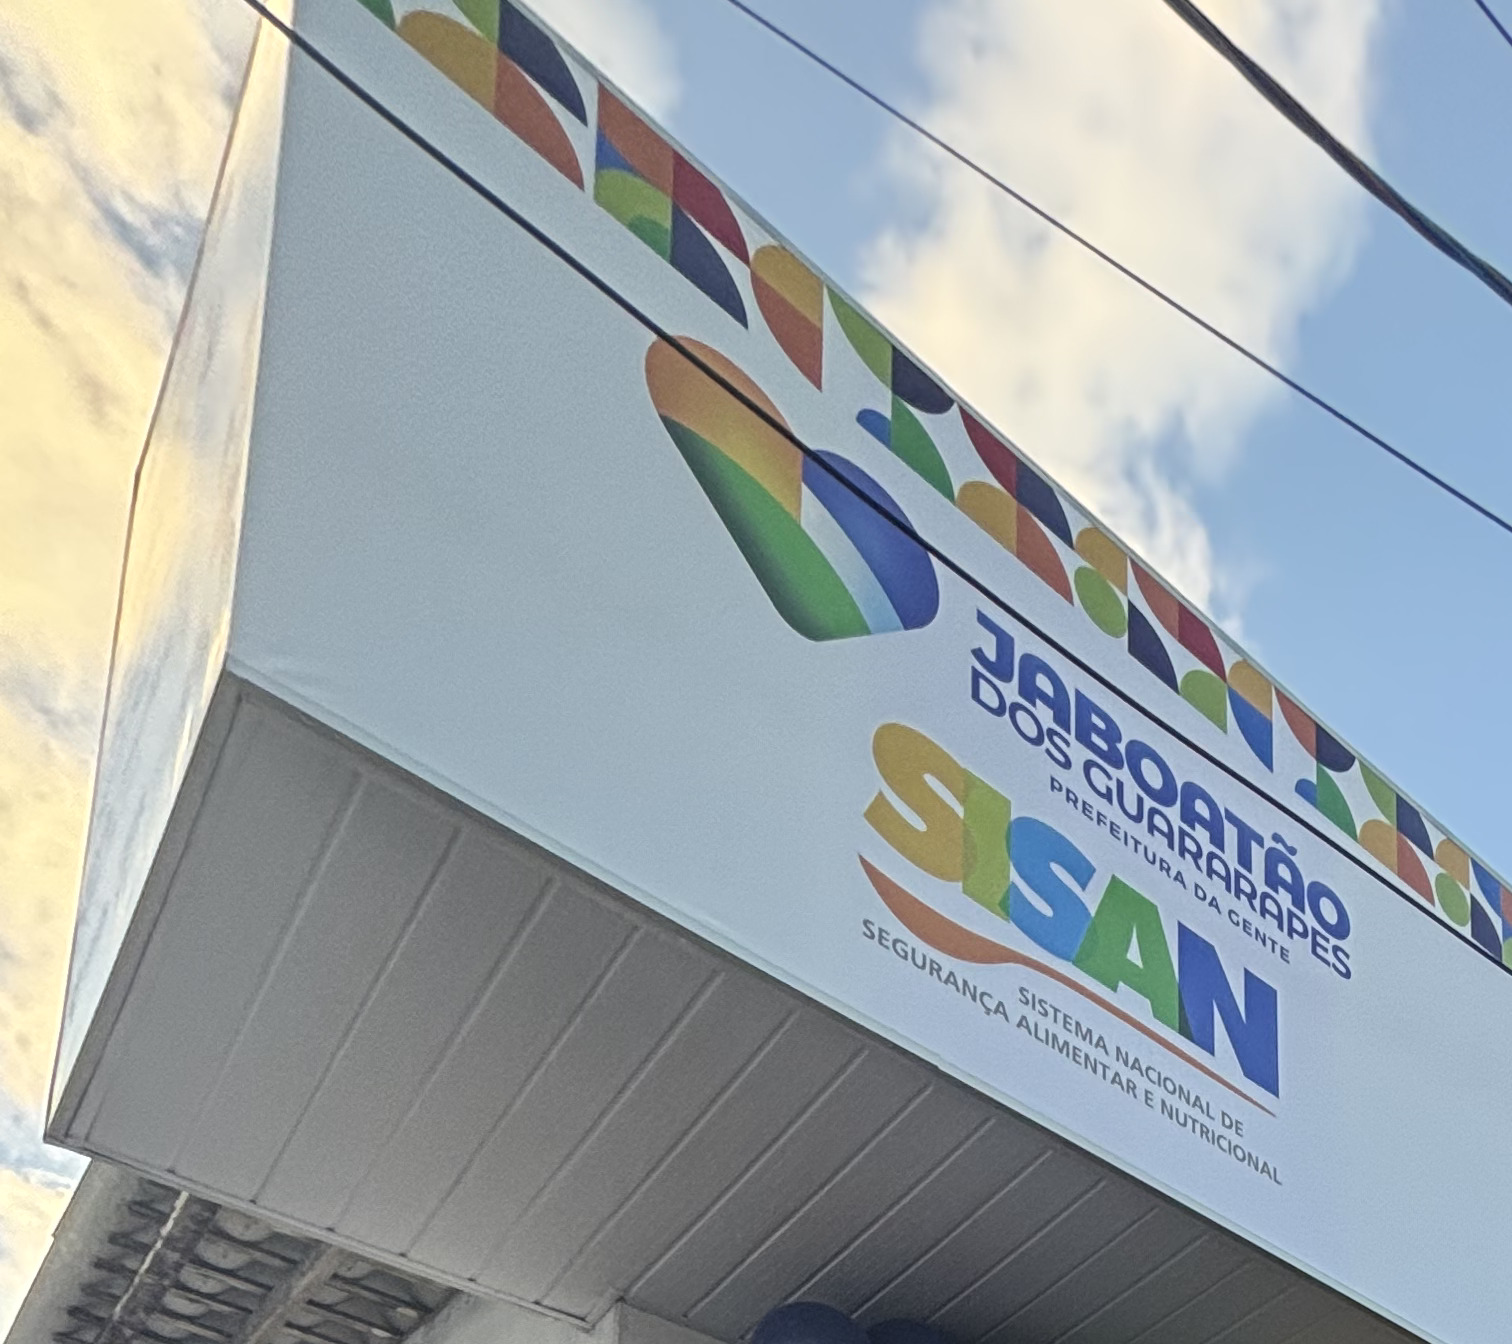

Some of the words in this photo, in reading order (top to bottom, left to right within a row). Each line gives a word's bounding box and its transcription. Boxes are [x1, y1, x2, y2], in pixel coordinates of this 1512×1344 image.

[863, 722, 1280, 1099] SISAN
[969, 608, 1351, 941] JABOATÃO
[970, 665, 1072, 772] DOS
[1083, 761, 1352, 981] GUARARAPES
[1050, 775, 1187, 891] PREFEITURA
[1194, 882, 1222, 917] DA
[1227, 906, 1291, 964] GENTE
[861, 918, 1010, 1025] SEGURANÇA
[1016, 1013, 1138, 1104] ALIMENTAR
[1143, 1088, 1155, 1109] E
[1160, 1098, 1283, 1187] NUTRICIONAL
[1018, 985, 1109, 1057] SISTEMA
[1116, 1043, 1216, 1123] NACIONAL
[1221, 1109, 1244, 1139] DE
